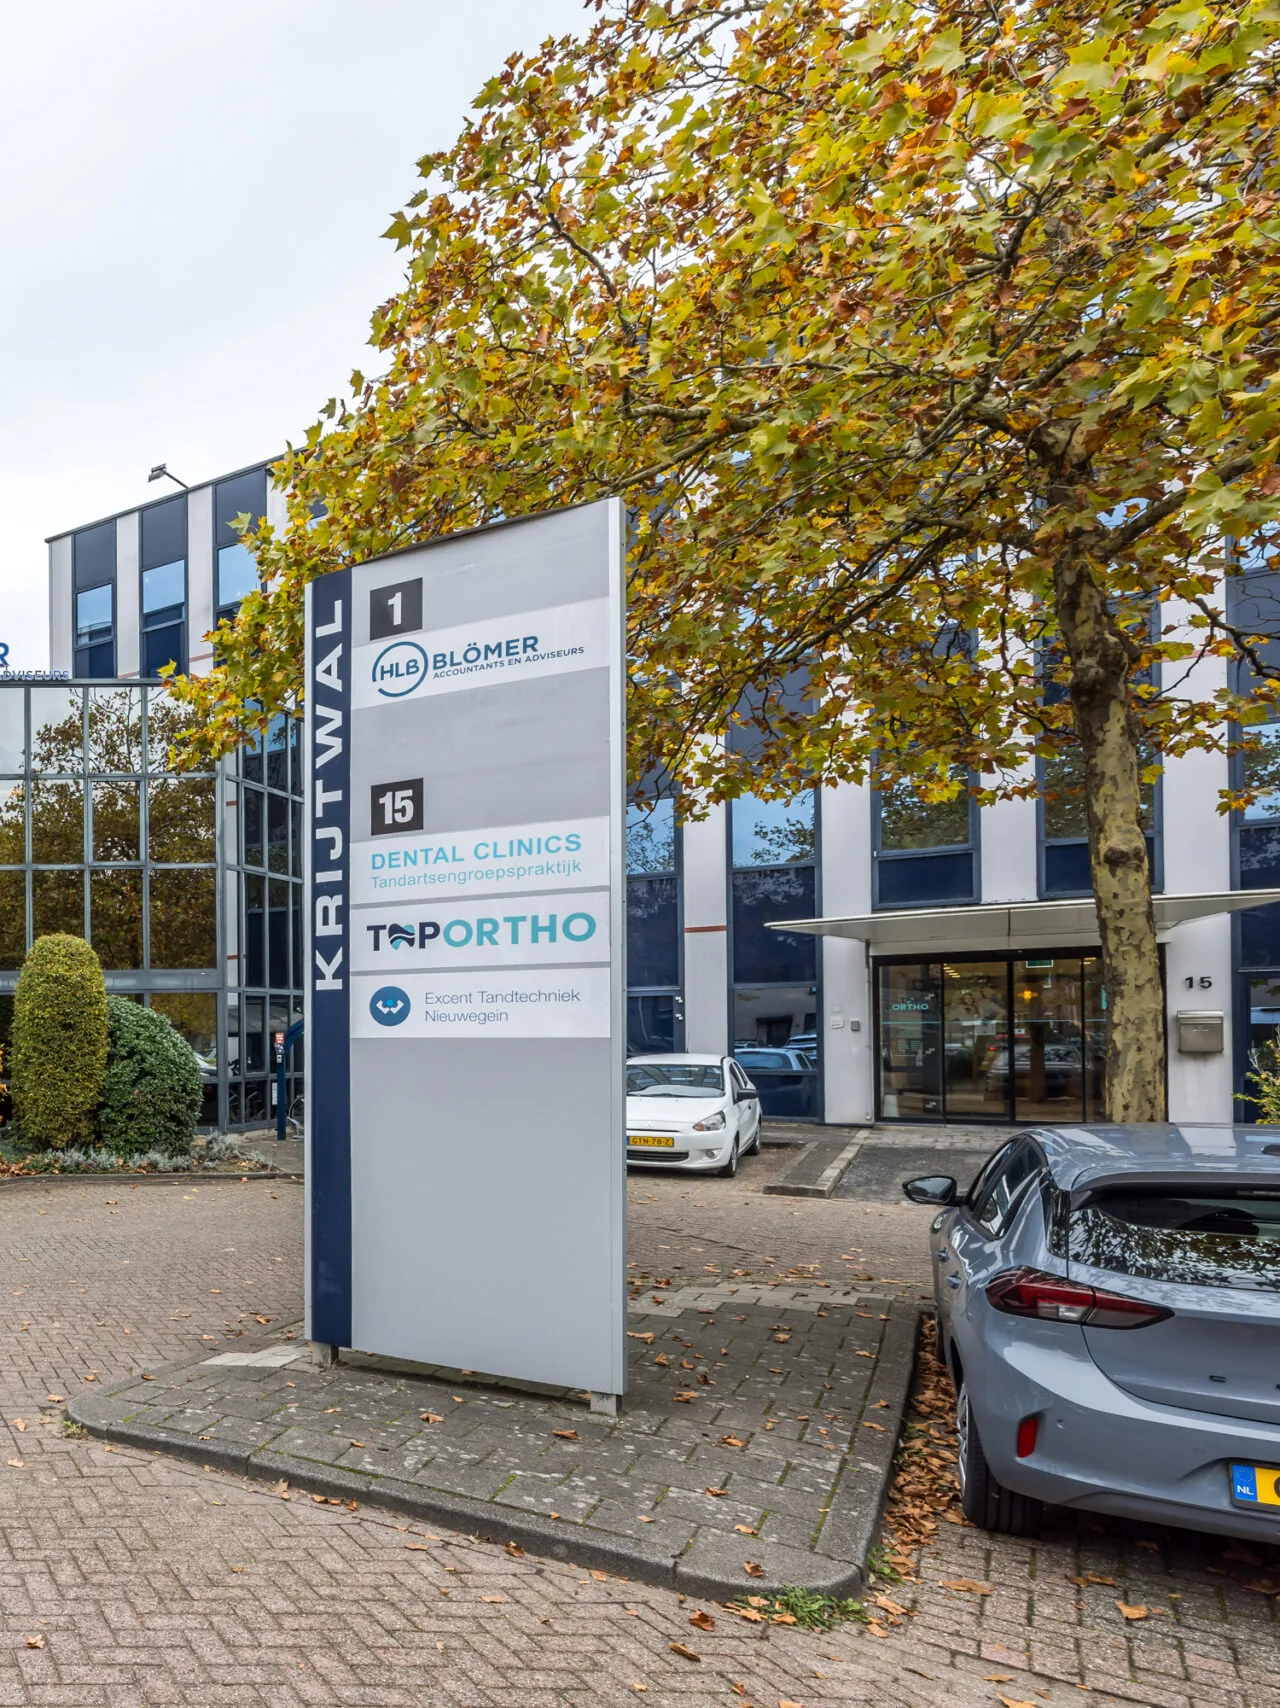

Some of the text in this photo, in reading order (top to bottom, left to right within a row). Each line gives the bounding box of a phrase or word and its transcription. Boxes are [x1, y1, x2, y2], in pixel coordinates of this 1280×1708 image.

[387, 591, 403, 627] 1
[380, 635, 539, 682] HLB BLÖMER
[432, 646, 585, 680] ACCOUNTANTS EN ADVISEURS
[315, 599, 343, 991] KRIJTWAL
[378, 788, 415, 826] 15
[370, 833, 582, 871] DENTAL CLINICS
[370, 859, 583, 889] Tandartsengroepspraktijk
[425, 988, 581, 1005] Excent Tandtechniek
[1185, 976, 1212, 989] 15
[424, 1008, 509, 1025] Nieuwegein
[1237, 1485, 1254, 1496] NL
